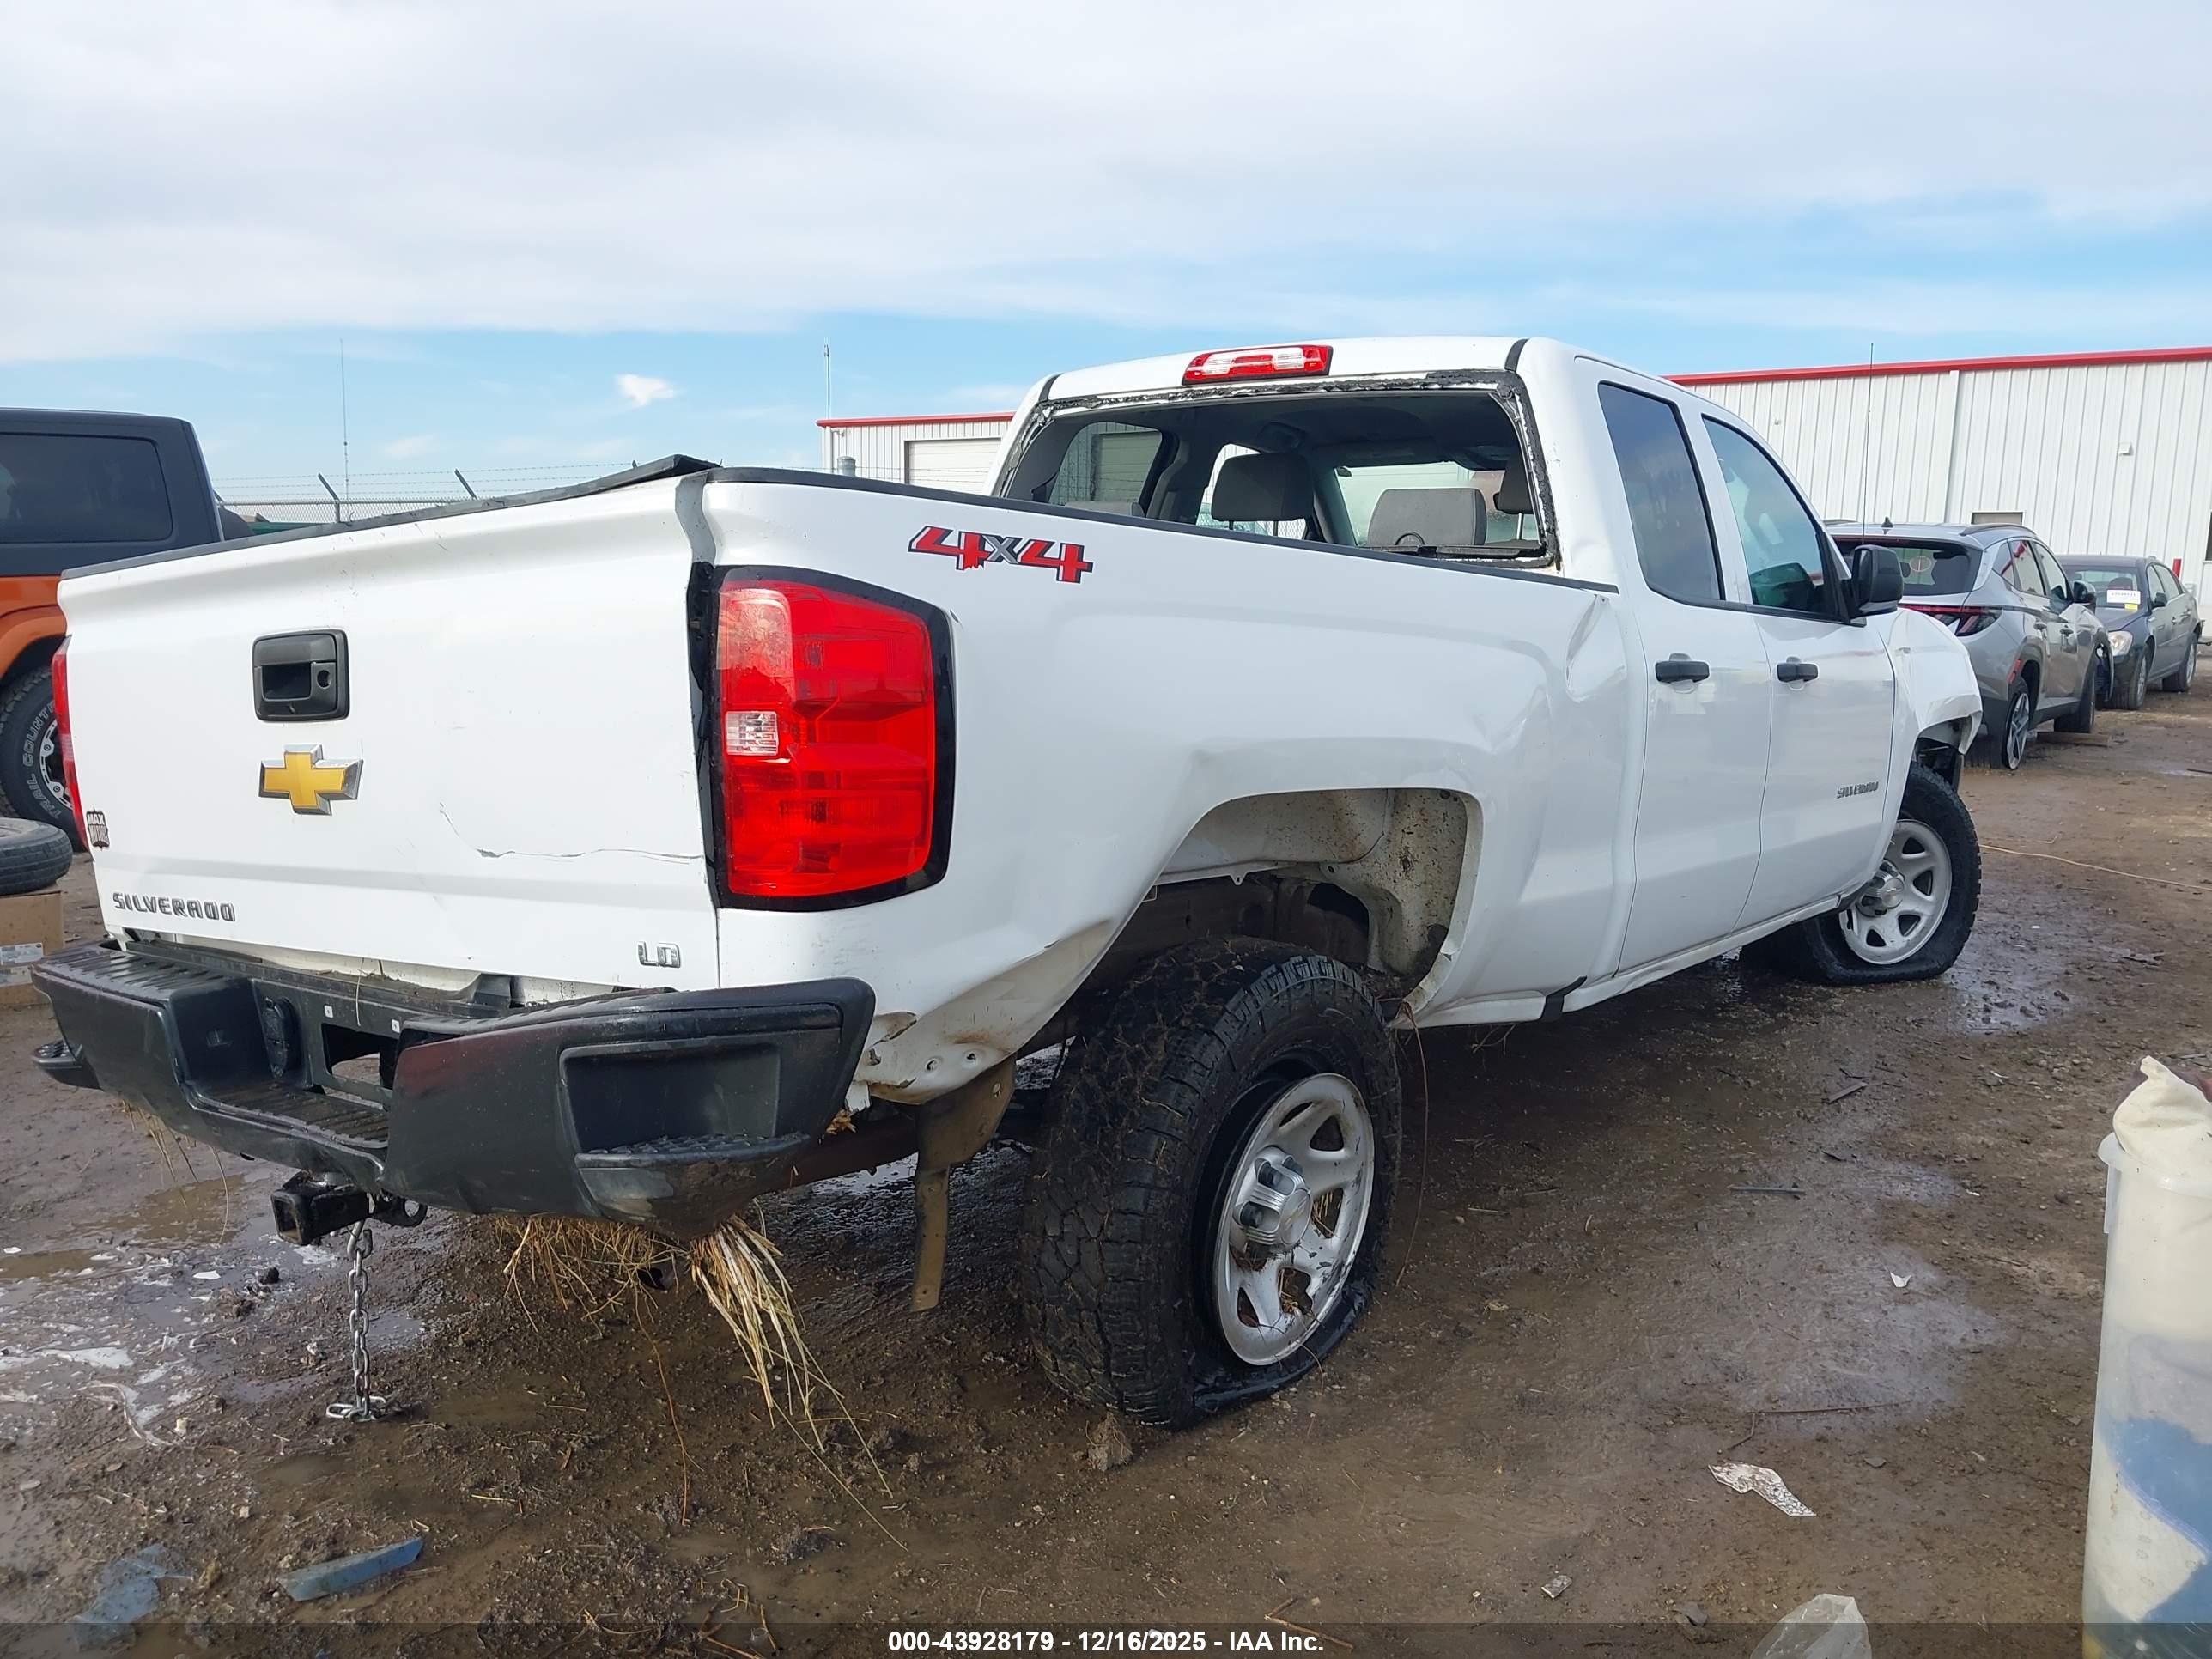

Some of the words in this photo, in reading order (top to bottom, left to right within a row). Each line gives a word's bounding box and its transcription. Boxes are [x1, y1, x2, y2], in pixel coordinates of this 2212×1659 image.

[27, 773, 62, 819] TRAIL
[87, 813, 106, 825] MAX
[112, 892, 236, 922] SILVERADO
[637, 942, 681, 969] LD
